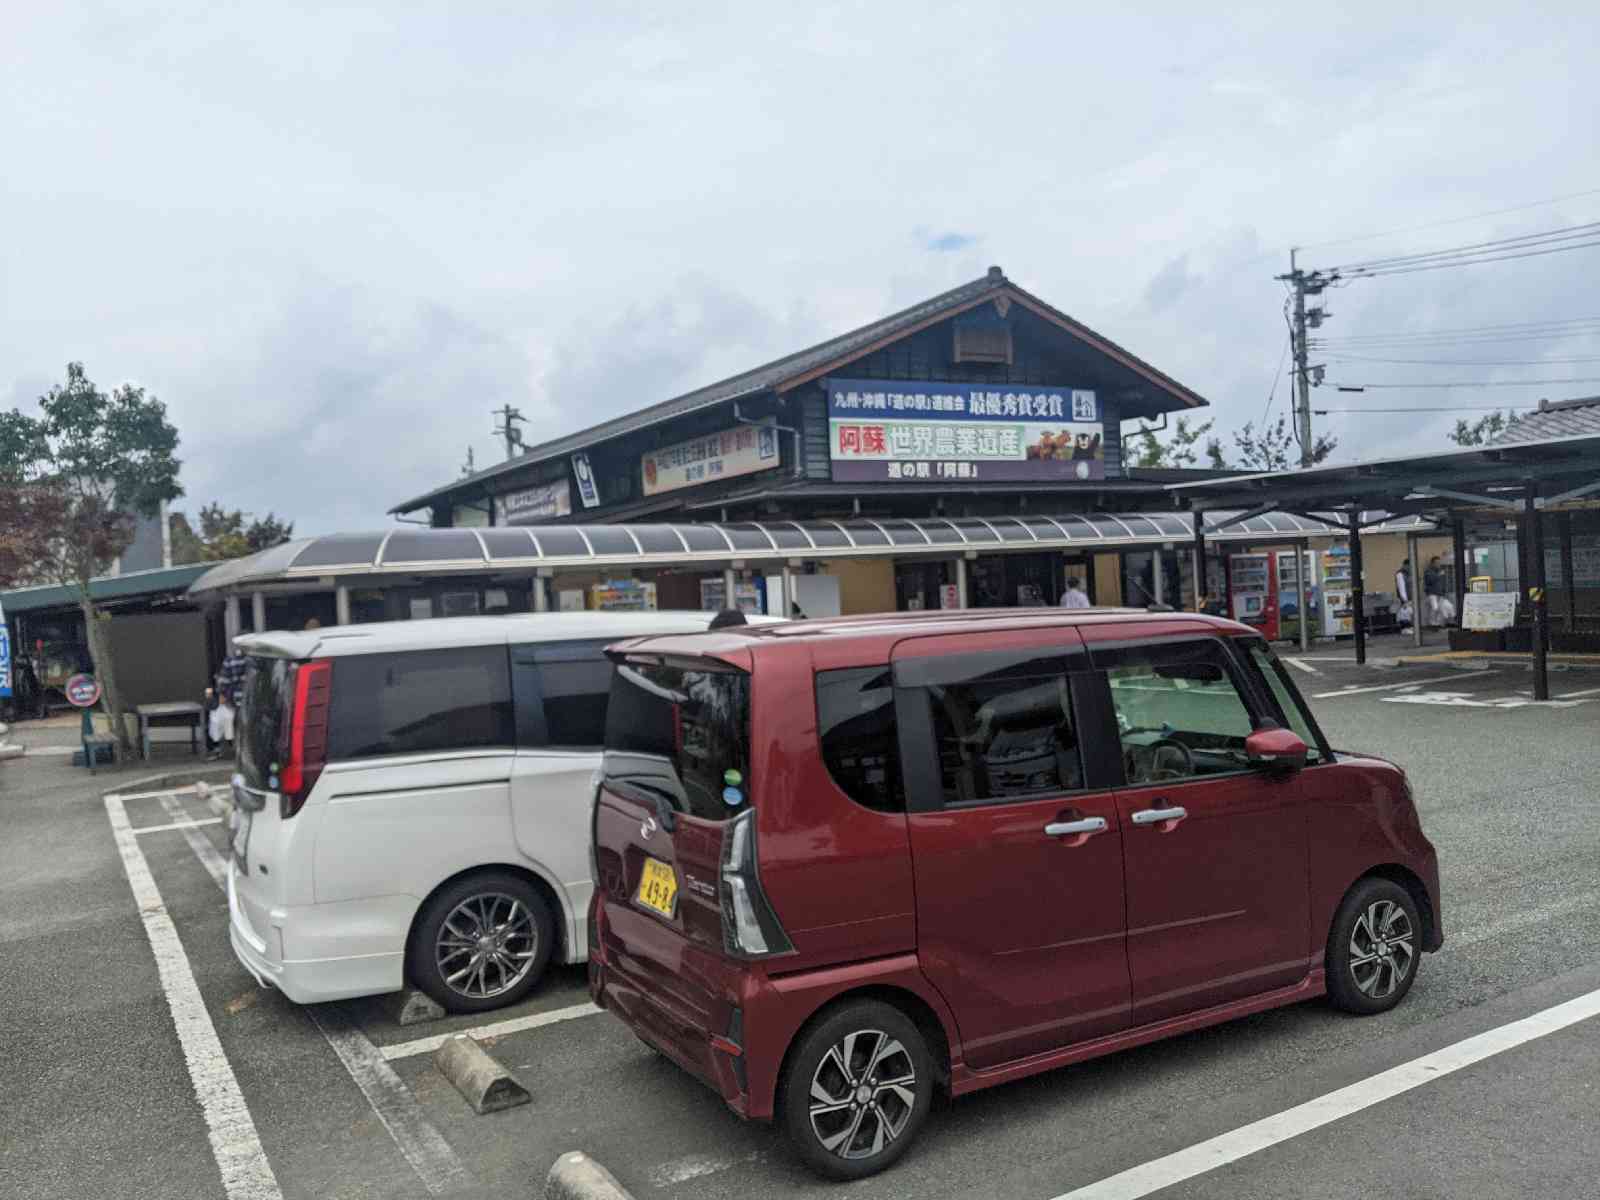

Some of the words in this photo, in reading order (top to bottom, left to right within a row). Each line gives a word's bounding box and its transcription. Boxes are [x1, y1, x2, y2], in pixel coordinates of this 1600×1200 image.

[838, 425, 887, 454] 阿蘇
[890, 426, 1019, 457] 世界農業遺産
